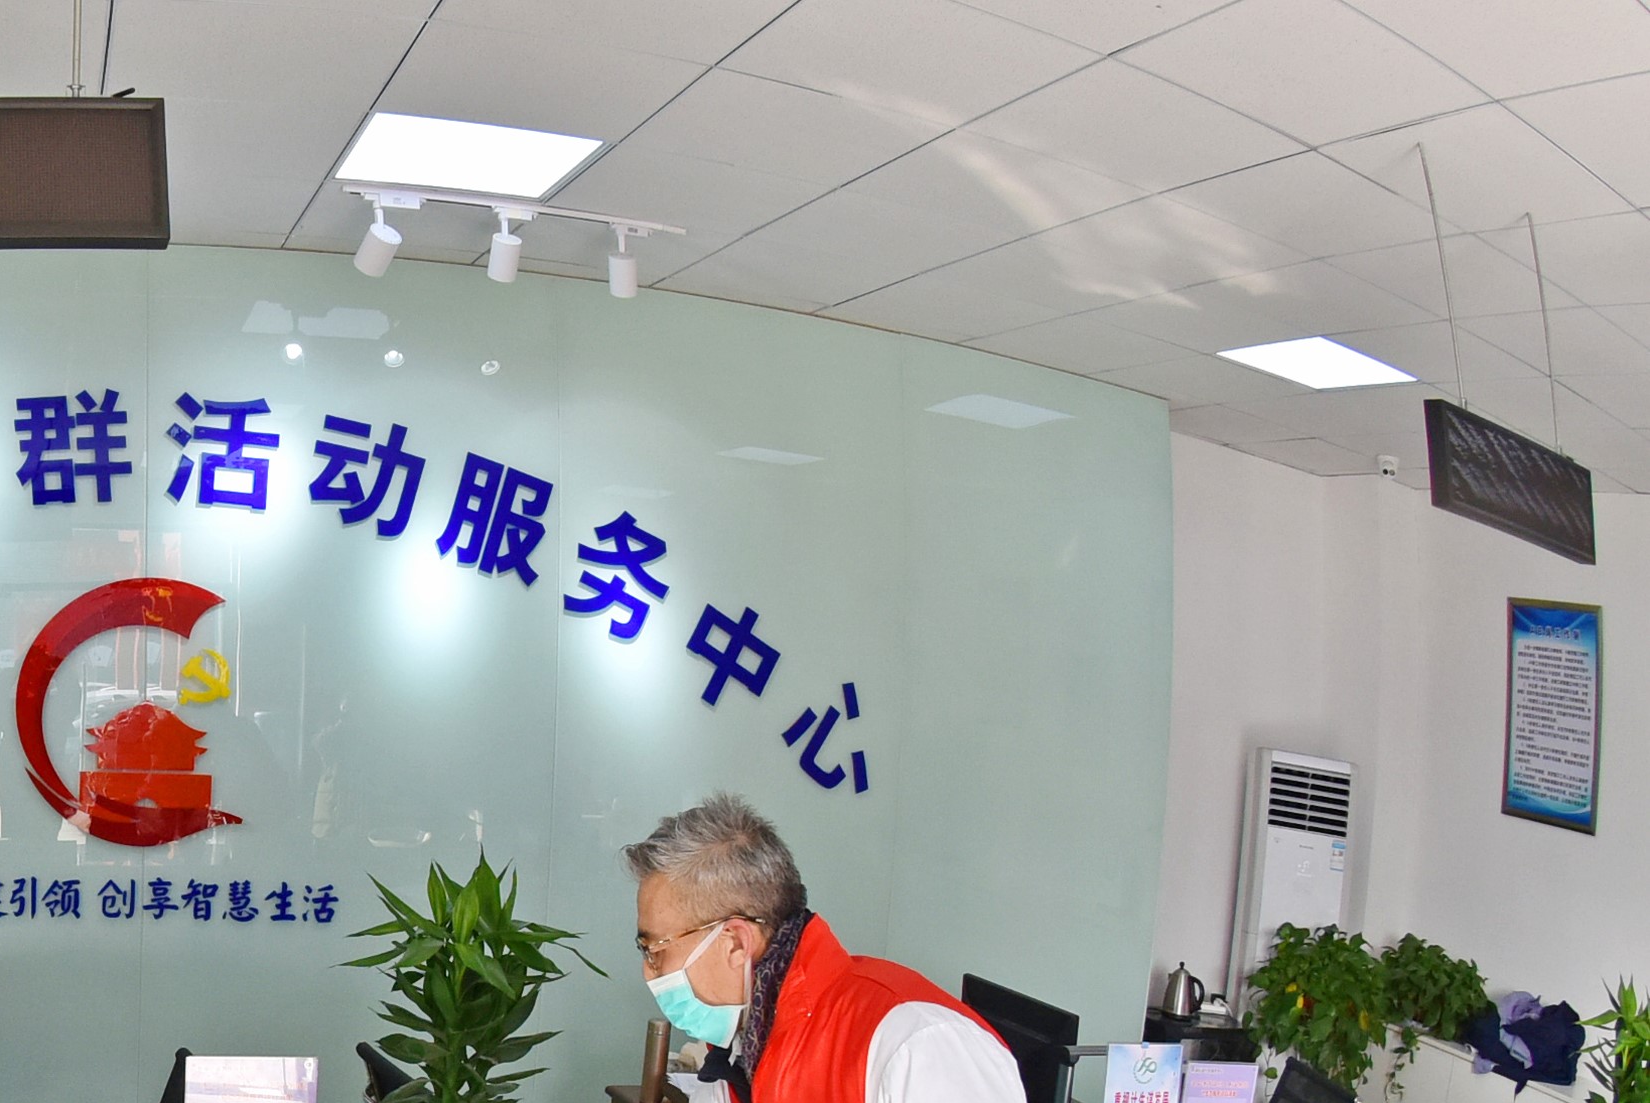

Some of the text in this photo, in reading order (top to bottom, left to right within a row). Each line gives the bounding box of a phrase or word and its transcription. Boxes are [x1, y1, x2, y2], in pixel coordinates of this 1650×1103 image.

[96, 878, 340, 924] 创享智慧生活
